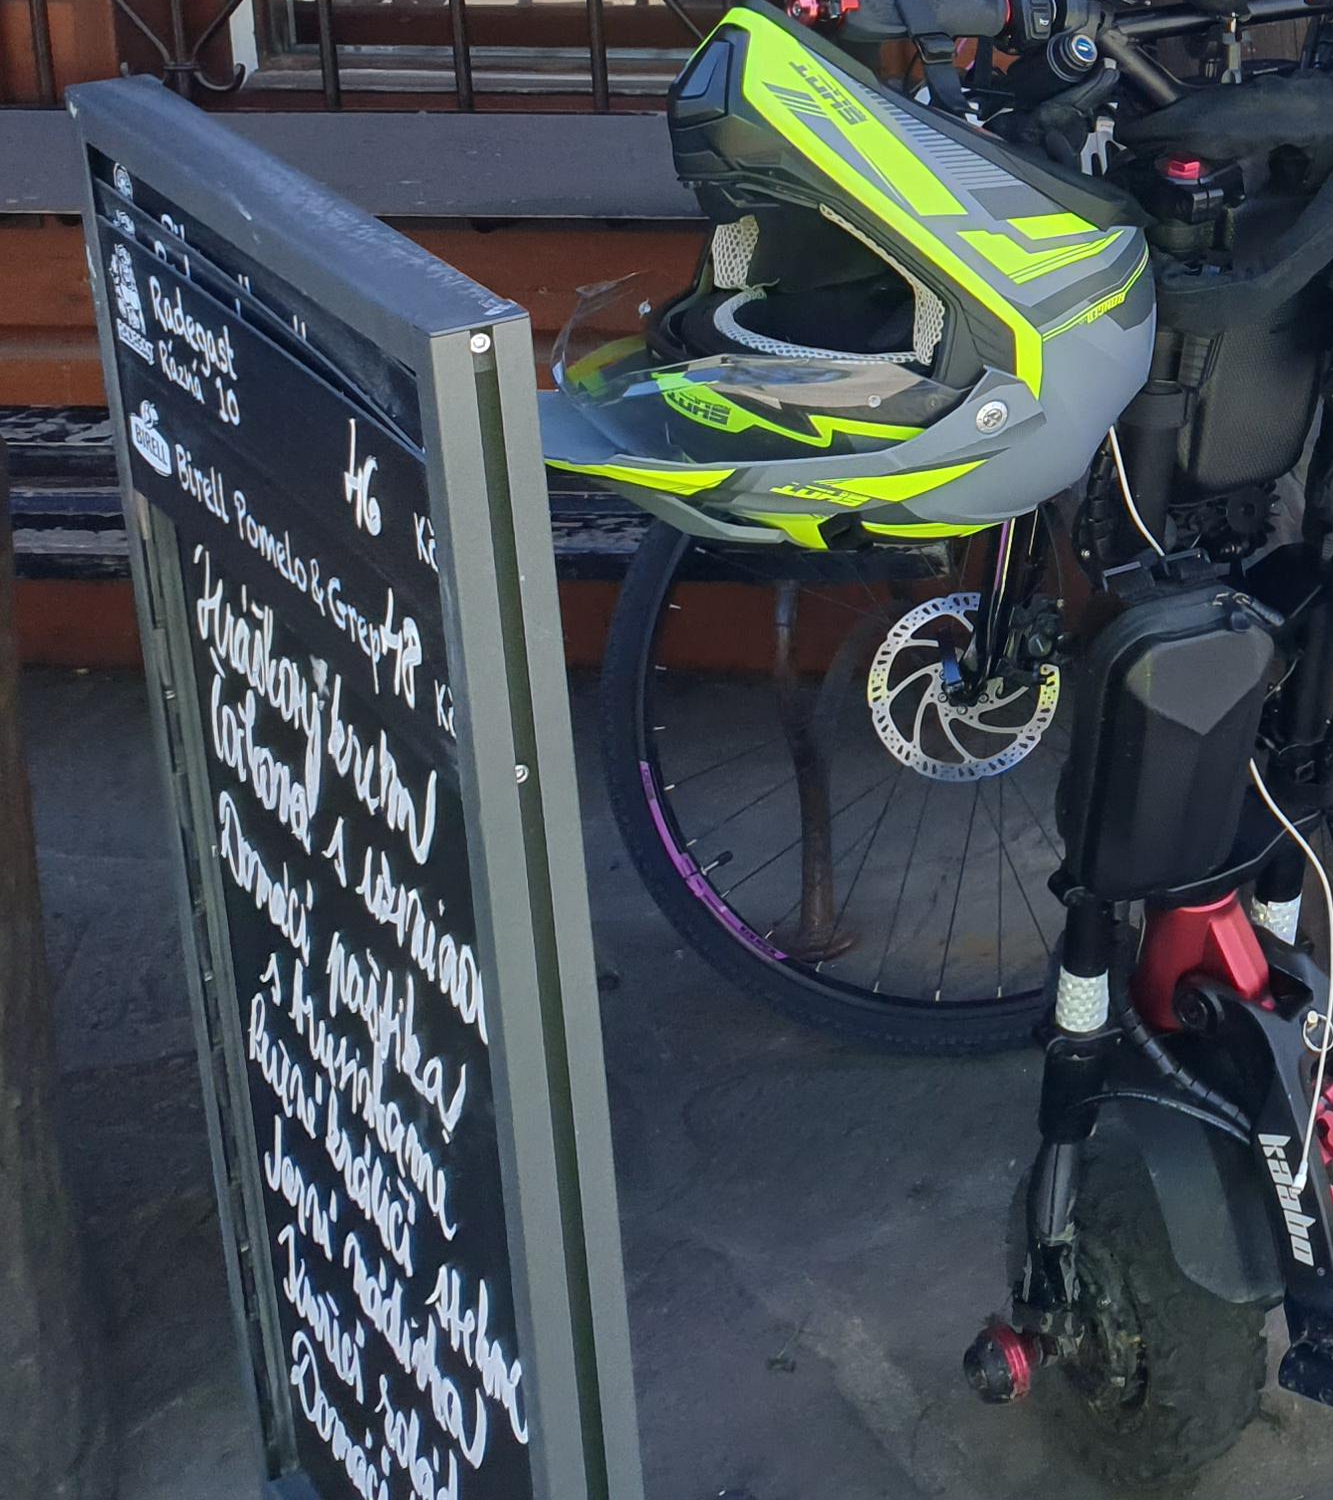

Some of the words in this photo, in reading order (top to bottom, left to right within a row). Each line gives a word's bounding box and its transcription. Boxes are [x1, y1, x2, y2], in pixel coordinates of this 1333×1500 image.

[135, 426, 169, 467] BIRELL
[151, 276, 237, 380] Radegast
[345, 420, 383, 536] 46
[159, 340, 205, 404] Rázná
[216, 377, 240, 426] 10
[175, 444, 230, 524] Birell
[235, 492, 308, 592] Pomelo
[311, 559, 326, 616] &
[328, 579, 381, 695] Grep
[1258, 1133, 1316, 1267] kaabo
